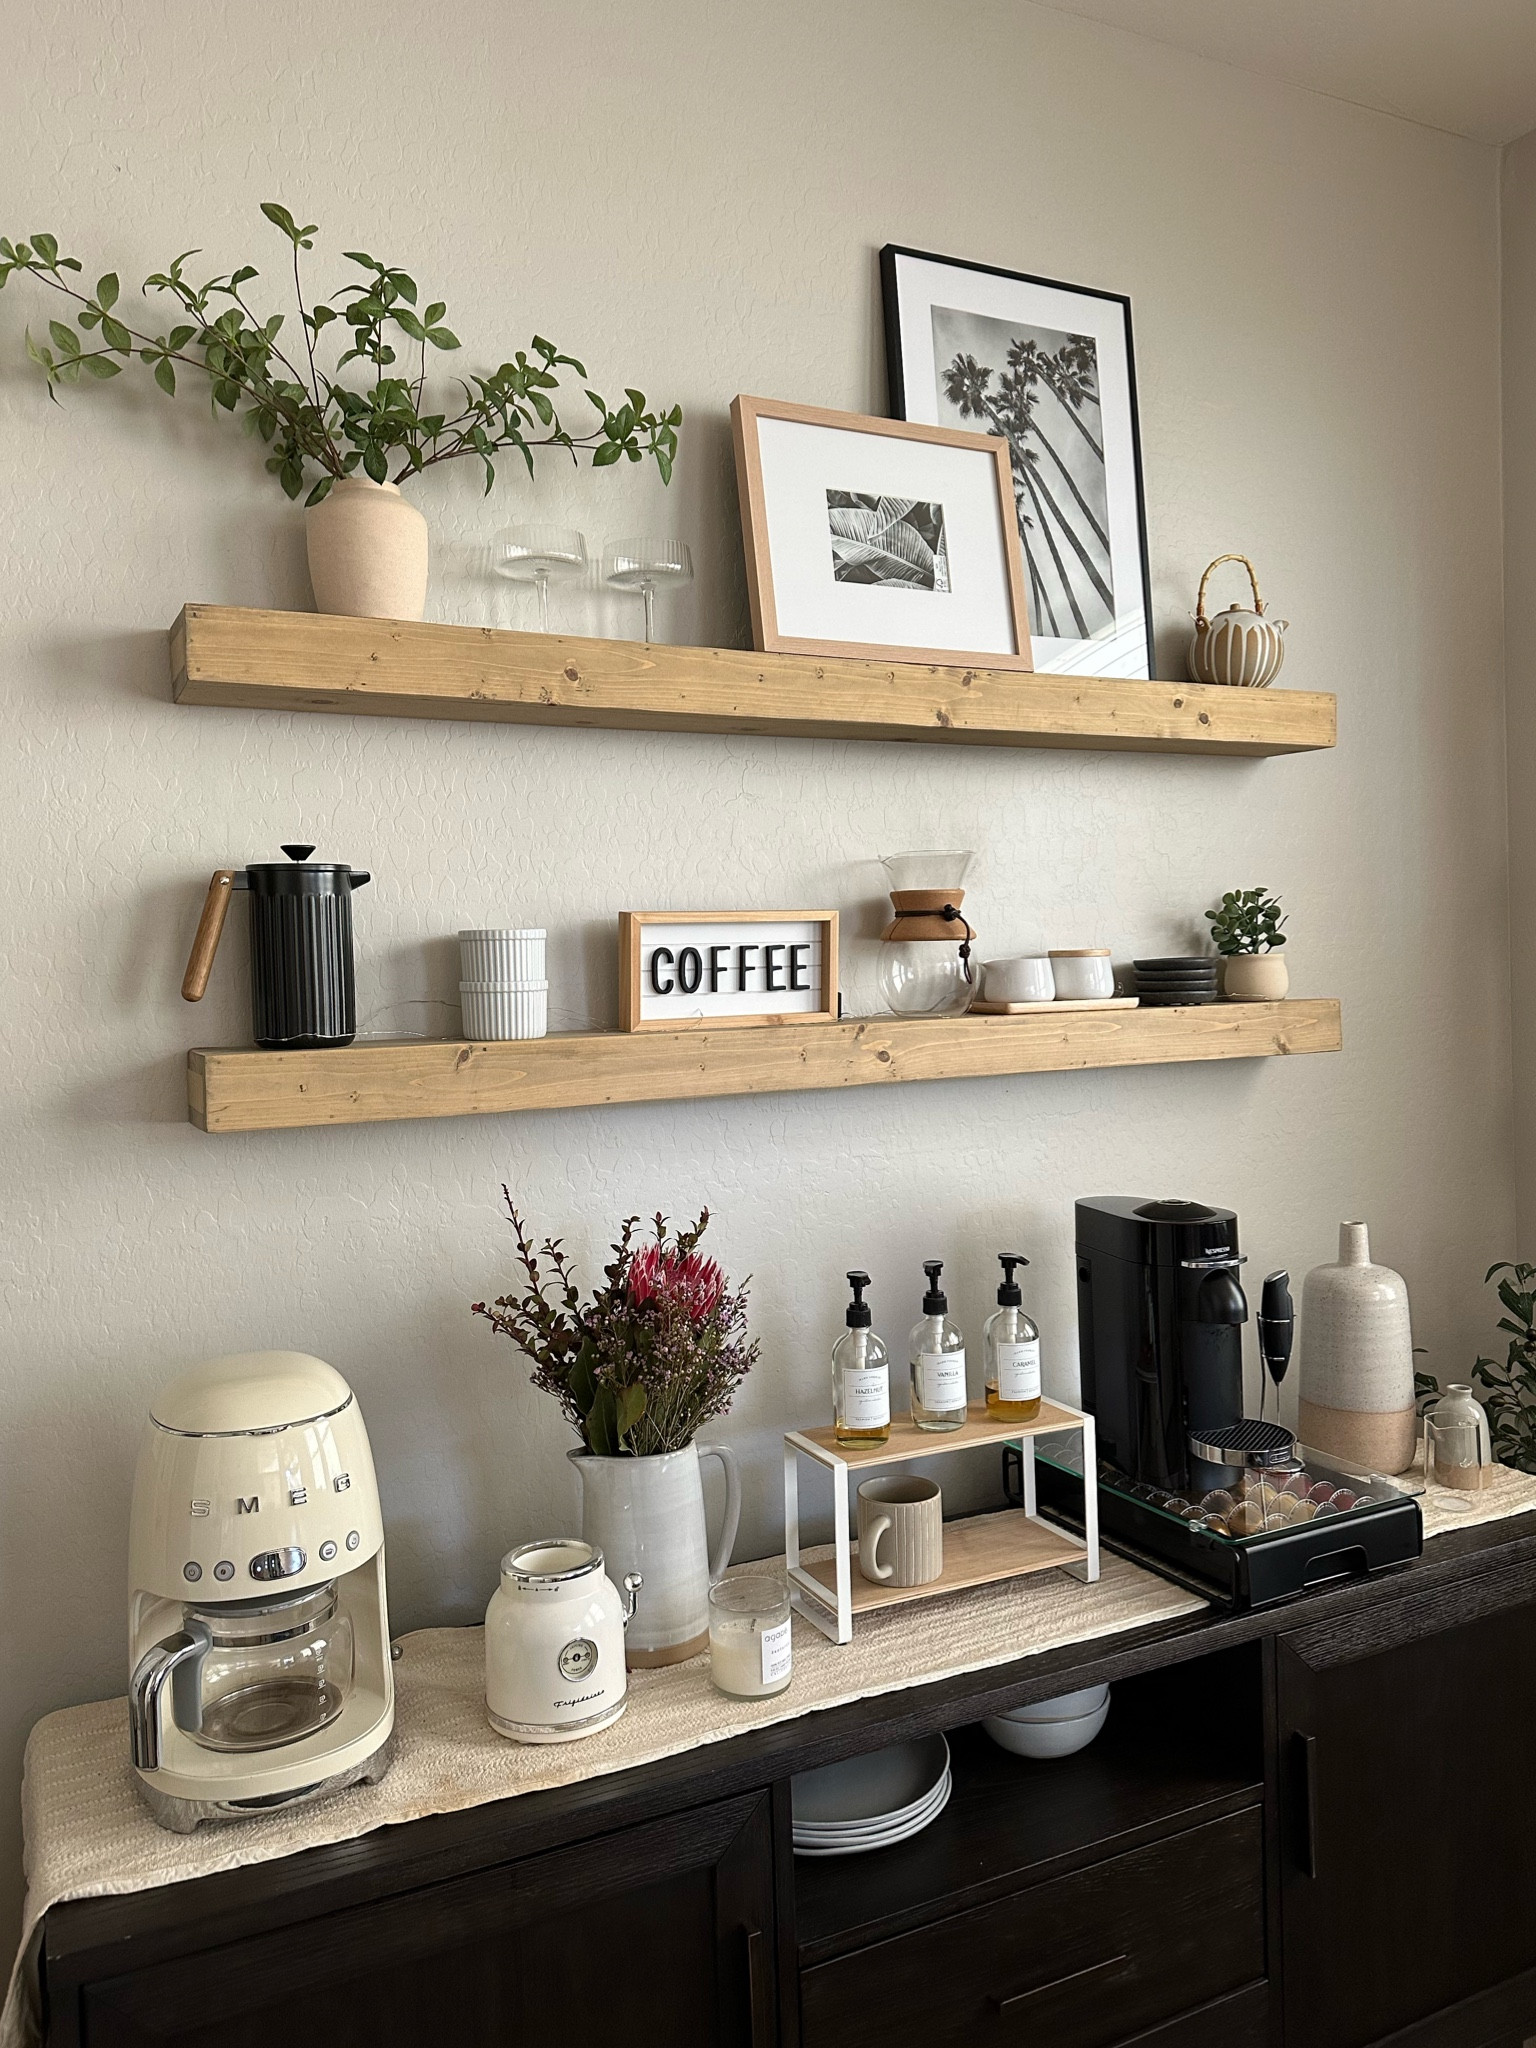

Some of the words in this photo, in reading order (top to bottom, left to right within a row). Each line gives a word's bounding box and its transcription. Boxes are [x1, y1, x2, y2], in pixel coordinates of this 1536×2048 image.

[651, 944, 811, 995] COFFEE
[855, 1386, 883, 1394] HAZELNUT
[190, 1473, 351, 1518] SMEG
[553, 1690, 604, 1708] Frigidaire
